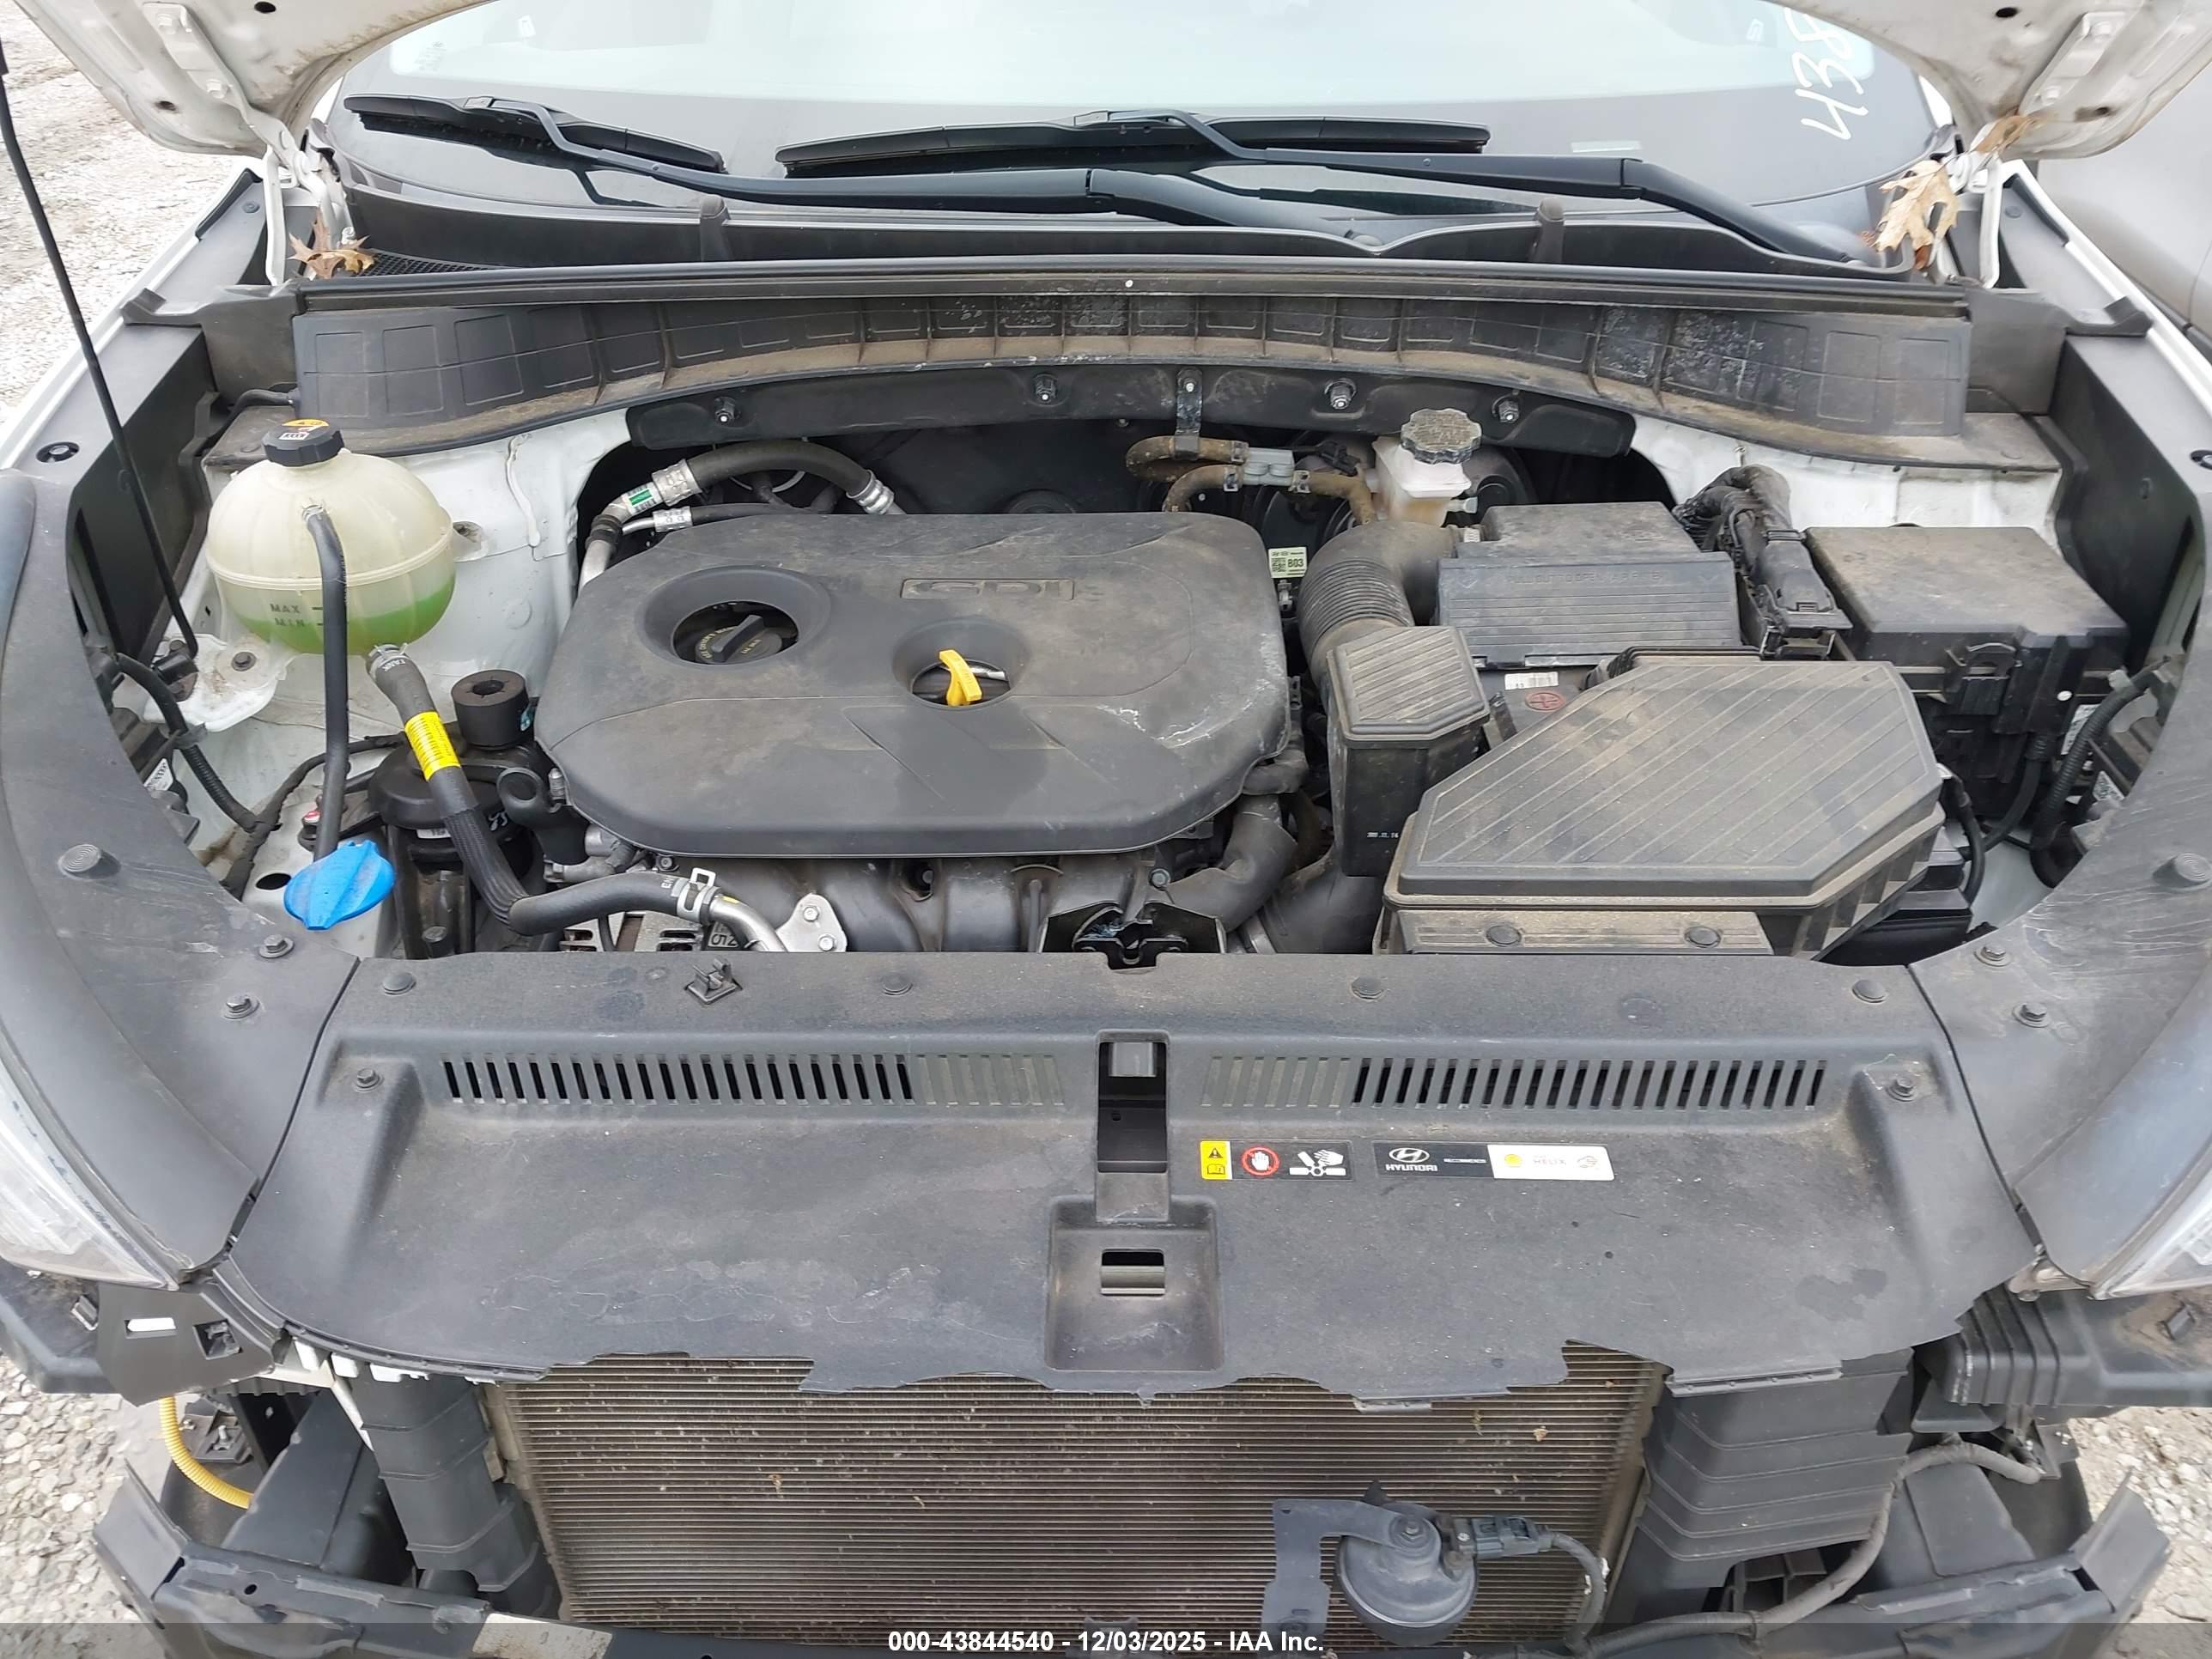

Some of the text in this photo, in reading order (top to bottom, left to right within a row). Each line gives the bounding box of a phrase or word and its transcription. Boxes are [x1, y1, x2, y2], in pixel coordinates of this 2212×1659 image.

[270, 604, 301, 613] MAX
[275, 617, 305, 627] MIN
[1385, 1164, 1438, 1172] HYUNDAI
